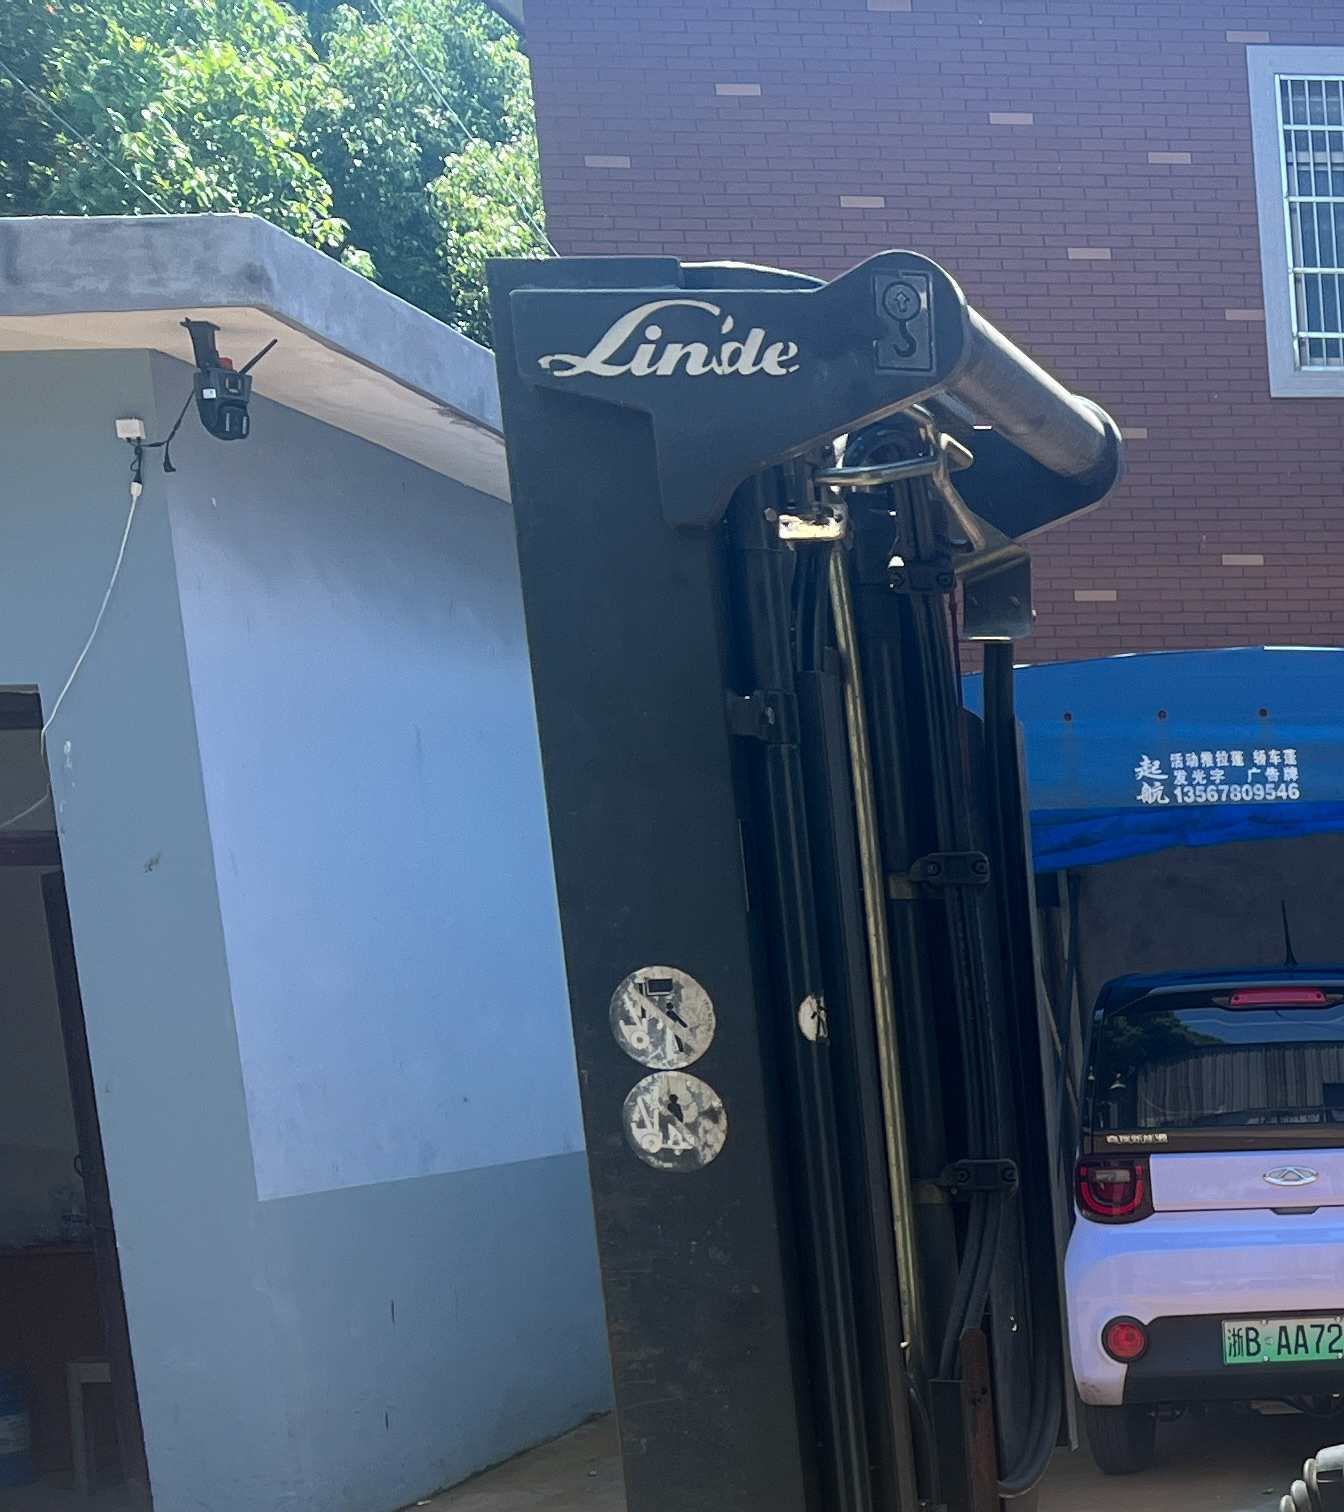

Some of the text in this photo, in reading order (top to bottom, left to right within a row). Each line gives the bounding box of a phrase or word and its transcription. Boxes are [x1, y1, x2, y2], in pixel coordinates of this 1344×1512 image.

[537, 299, 799, 378] Linde
[1134, 754, 1170, 804] 起航
[1173, 766, 1300, 785] 发光字 广告牌
[1173, 783, 1300, 803] 13567809546
